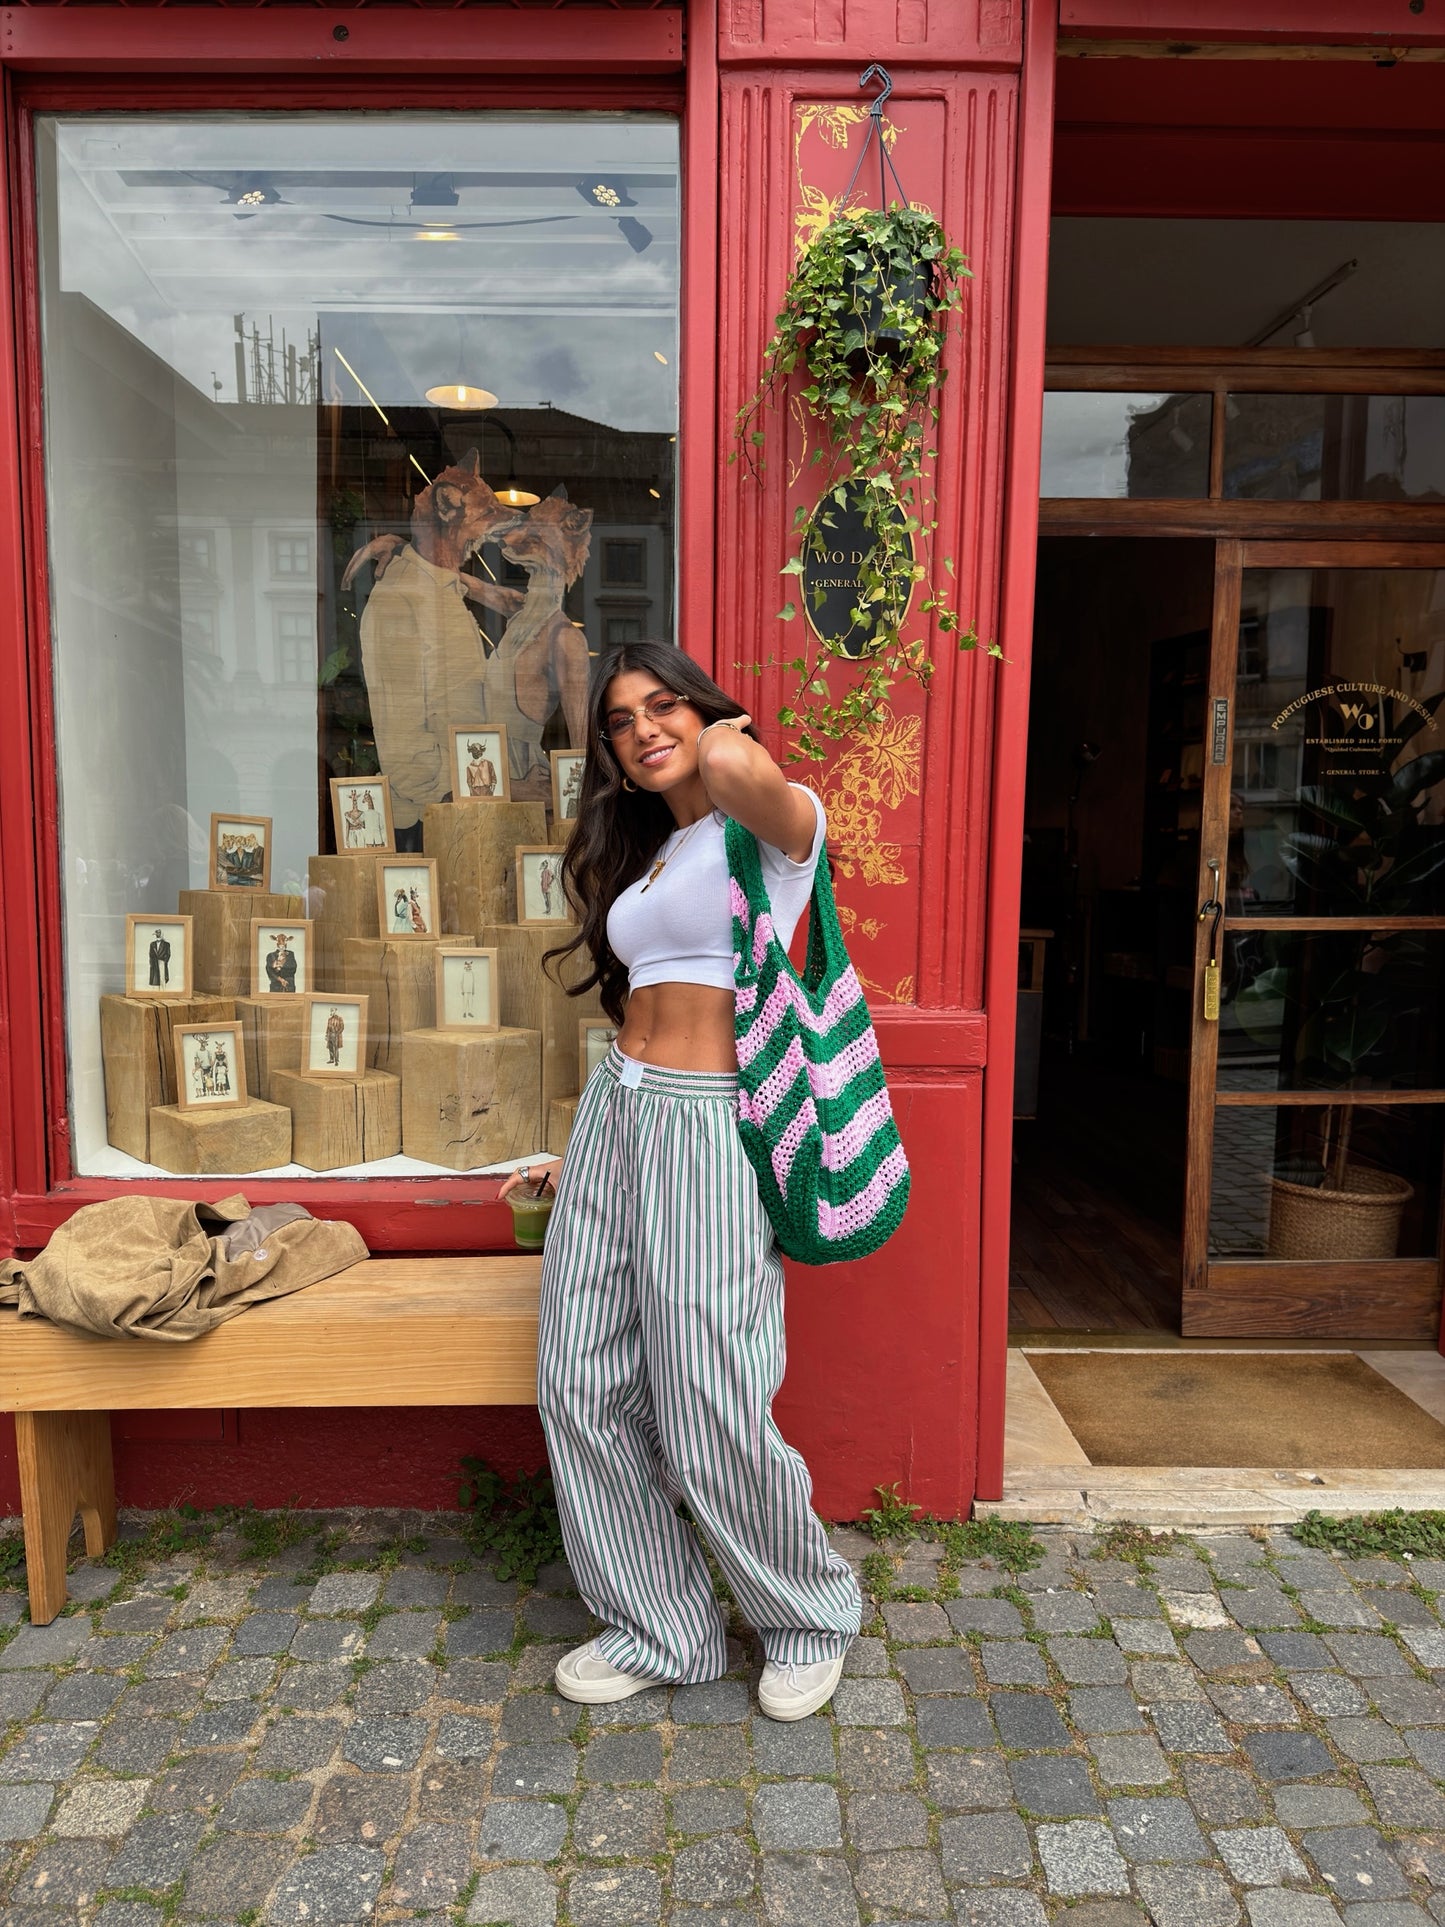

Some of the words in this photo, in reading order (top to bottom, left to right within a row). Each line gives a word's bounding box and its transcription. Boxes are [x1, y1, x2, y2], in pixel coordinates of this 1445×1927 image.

[815, 551, 845, 564] WO
[815, 579, 864, 588] GENERAL
[1271, 685, 1335, 730] PORTUGUESE
[1336, 682, 1386, 694] CULTURE
[1387, 688, 1409, 703] AND
[1408, 699, 1440, 732] DESIGN
[1215, 703, 1226, 760] EMPURRE
